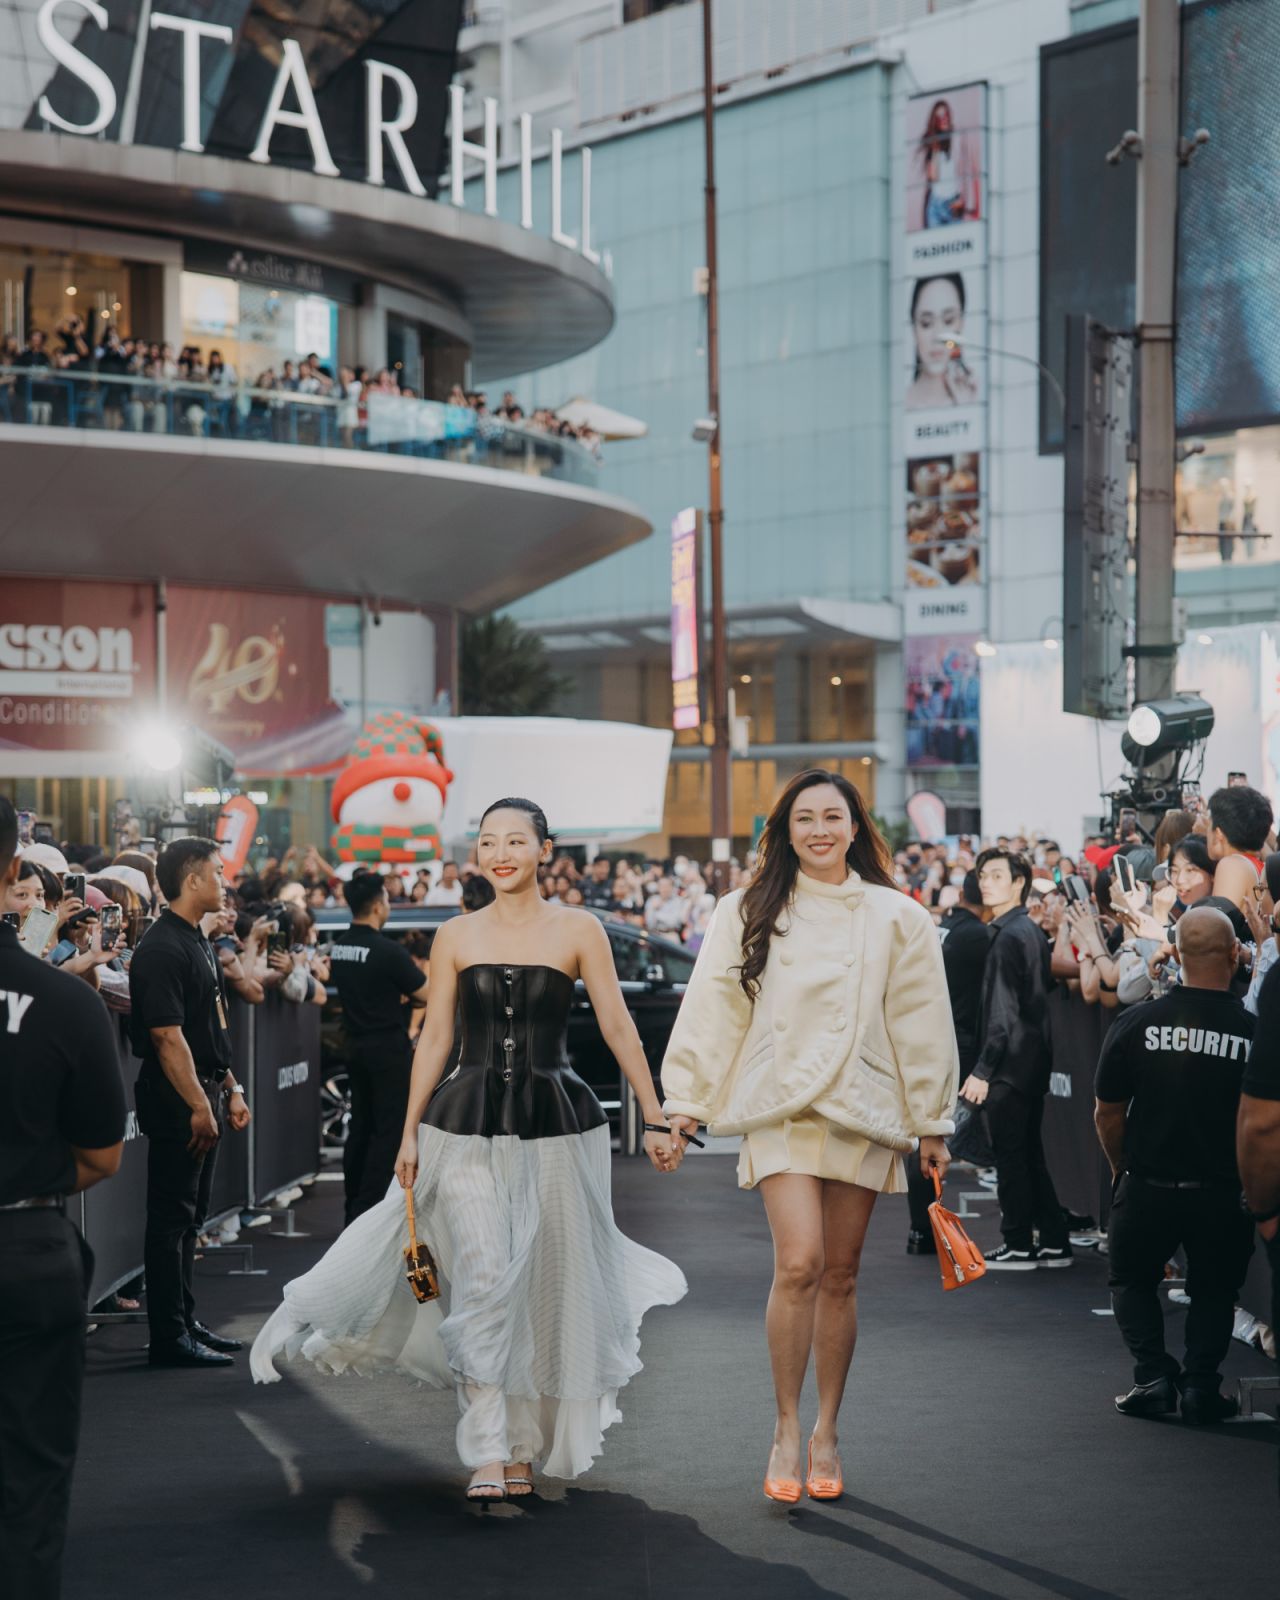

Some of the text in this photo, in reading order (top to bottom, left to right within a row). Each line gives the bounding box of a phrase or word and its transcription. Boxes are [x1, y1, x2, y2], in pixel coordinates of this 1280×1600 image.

[38, 0, 600, 265] STARHILL
[912, 240, 974, 259] FASHION
[915, 421, 970, 439] BEAUTY
[920, 602, 968, 618] DINING
[1145, 1025, 1253, 1063] SECURITY
